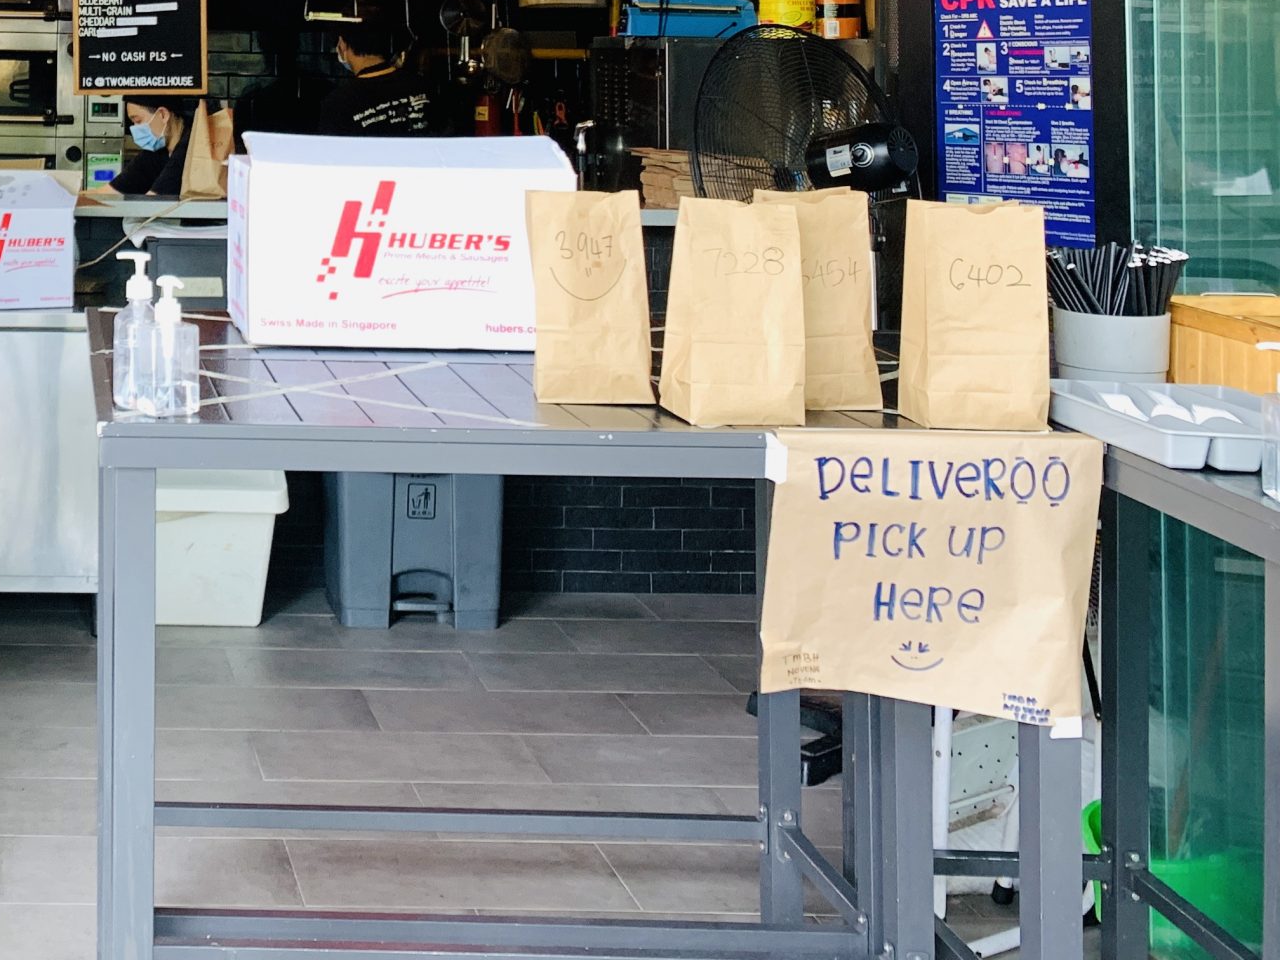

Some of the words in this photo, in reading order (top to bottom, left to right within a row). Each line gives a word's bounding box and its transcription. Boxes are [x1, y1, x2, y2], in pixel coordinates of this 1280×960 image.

[78, 5, 133, 16] MULTI-GRAIN
[78, 16, 116, 27] CHEDDAR
[942, 25, 949, 38] 1
[942, 43, 951, 56] 2
[1000, 42, 1009, 55] 3
[102, 51, 116, 62] NO
[121, 51, 146, 62] CASH
[149, 51, 167, 62] PLS
[82, 77, 93, 87] IG
[94, 76, 194, 88] @TWOMENBAGELHOUSE
[942, 79, 951, 92] 4
[1015, 80, 1024, 93] 5
[8, 237, 65, 247] HUBER'S
[387, 232, 512, 252] HUBER'S
[555, 230, 614, 261] 3947
[707, 245, 785, 276] 7228
[949, 258, 1032, 291] 6402
[260, 317, 292, 328] Swiss
[295, 318, 325, 329] Made
[328, 319, 338, 329] in
[341, 319, 397, 331] Singapore
[832, 521, 927, 560] PICK
